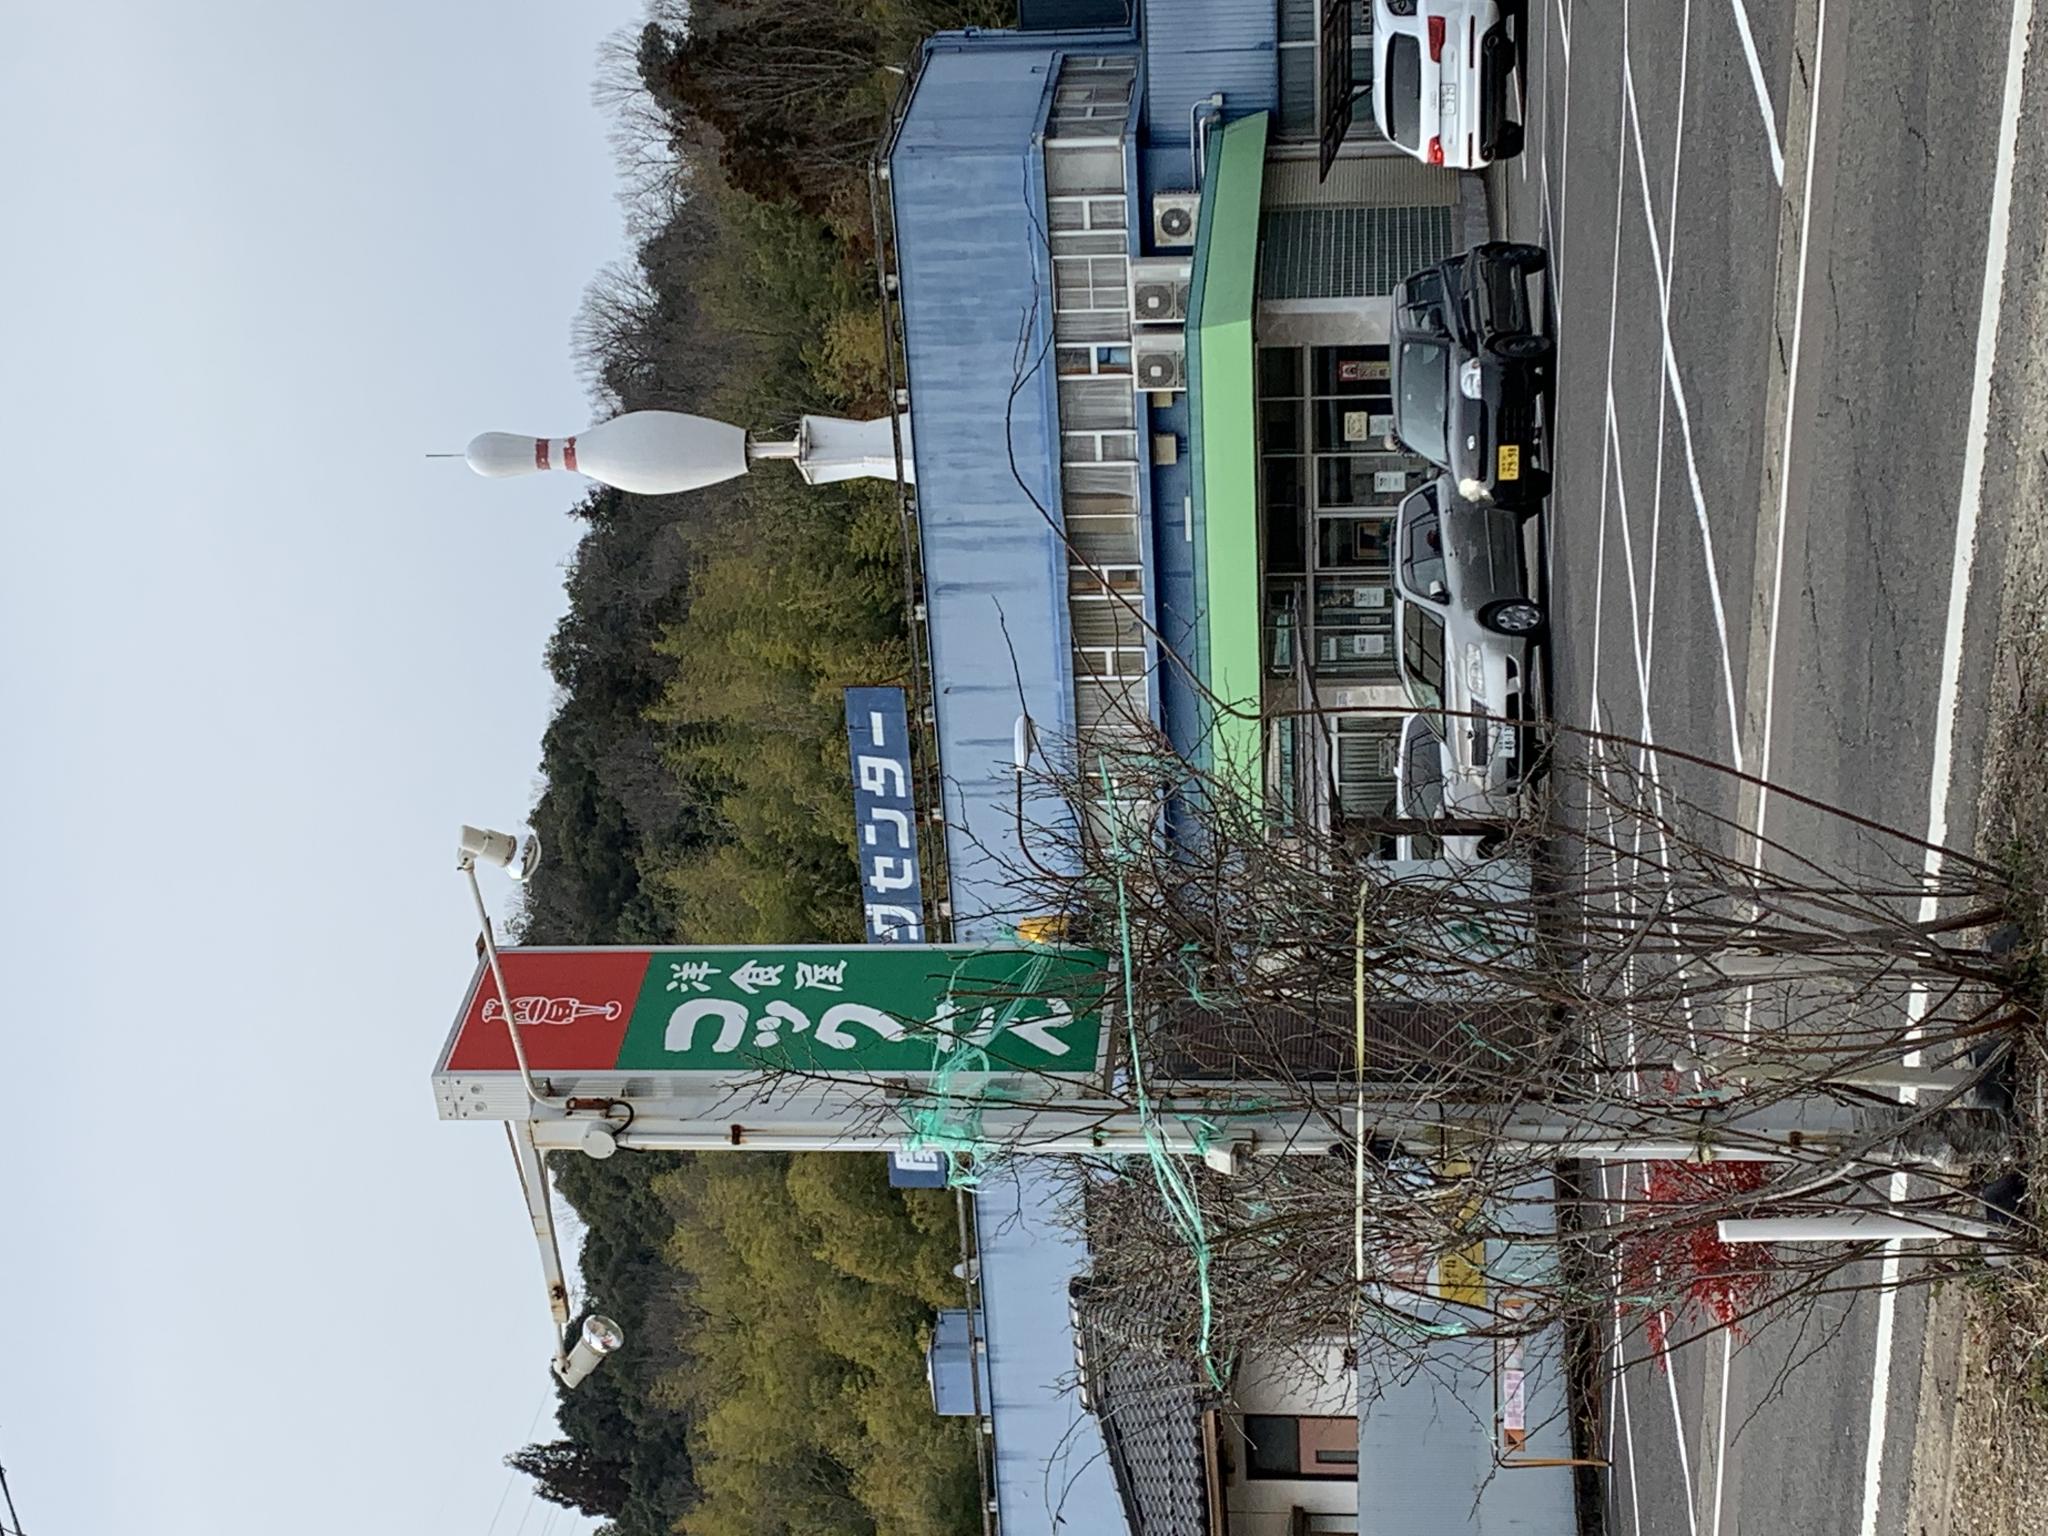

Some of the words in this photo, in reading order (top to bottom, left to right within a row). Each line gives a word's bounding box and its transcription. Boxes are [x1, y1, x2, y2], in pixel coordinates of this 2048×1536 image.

[666, 959, 847, 994] 洋食屋
[664, 998, 1075, 1056] コックさん
